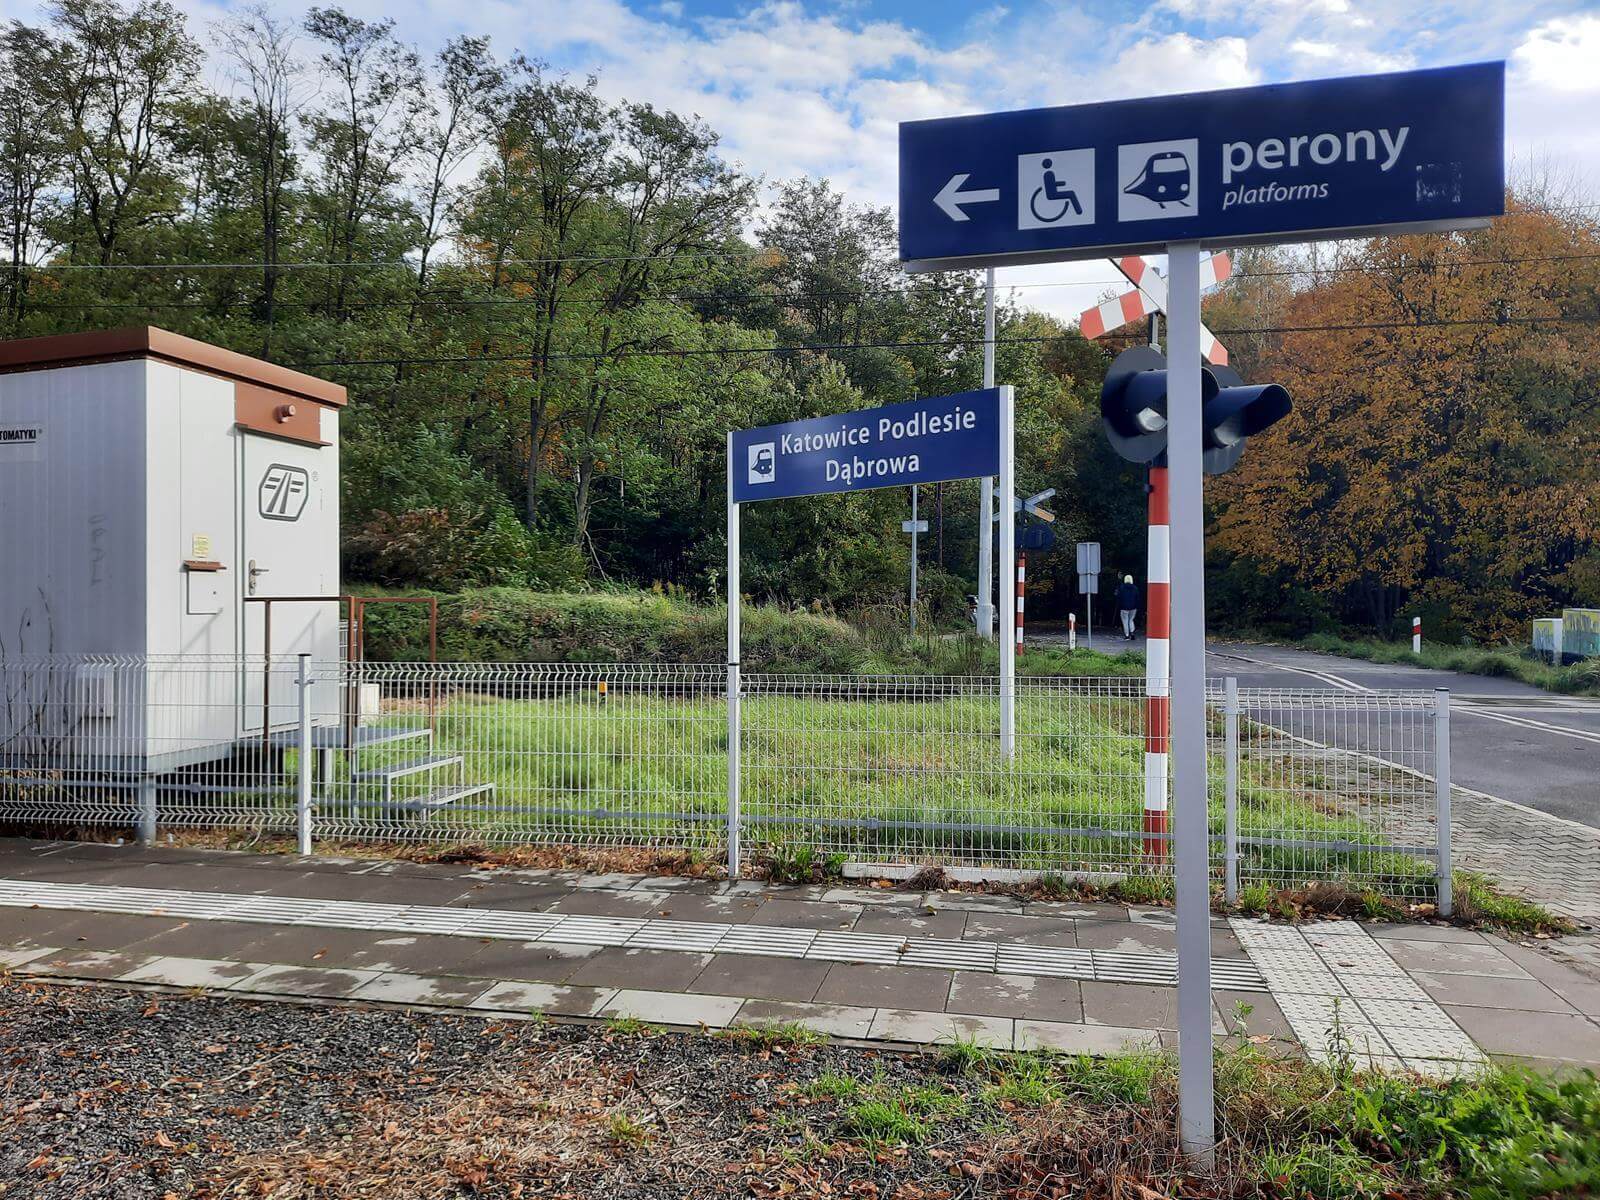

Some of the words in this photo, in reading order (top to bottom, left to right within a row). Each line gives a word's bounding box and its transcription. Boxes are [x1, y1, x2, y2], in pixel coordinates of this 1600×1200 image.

[1222, 127, 1410, 184] perony
[1222, 182, 1329, 210] platforms
[780, 426, 870, 455] Katowice
[879, 406, 976, 441] Podlesie
[826, 454, 920, 485] Dąbrowa
